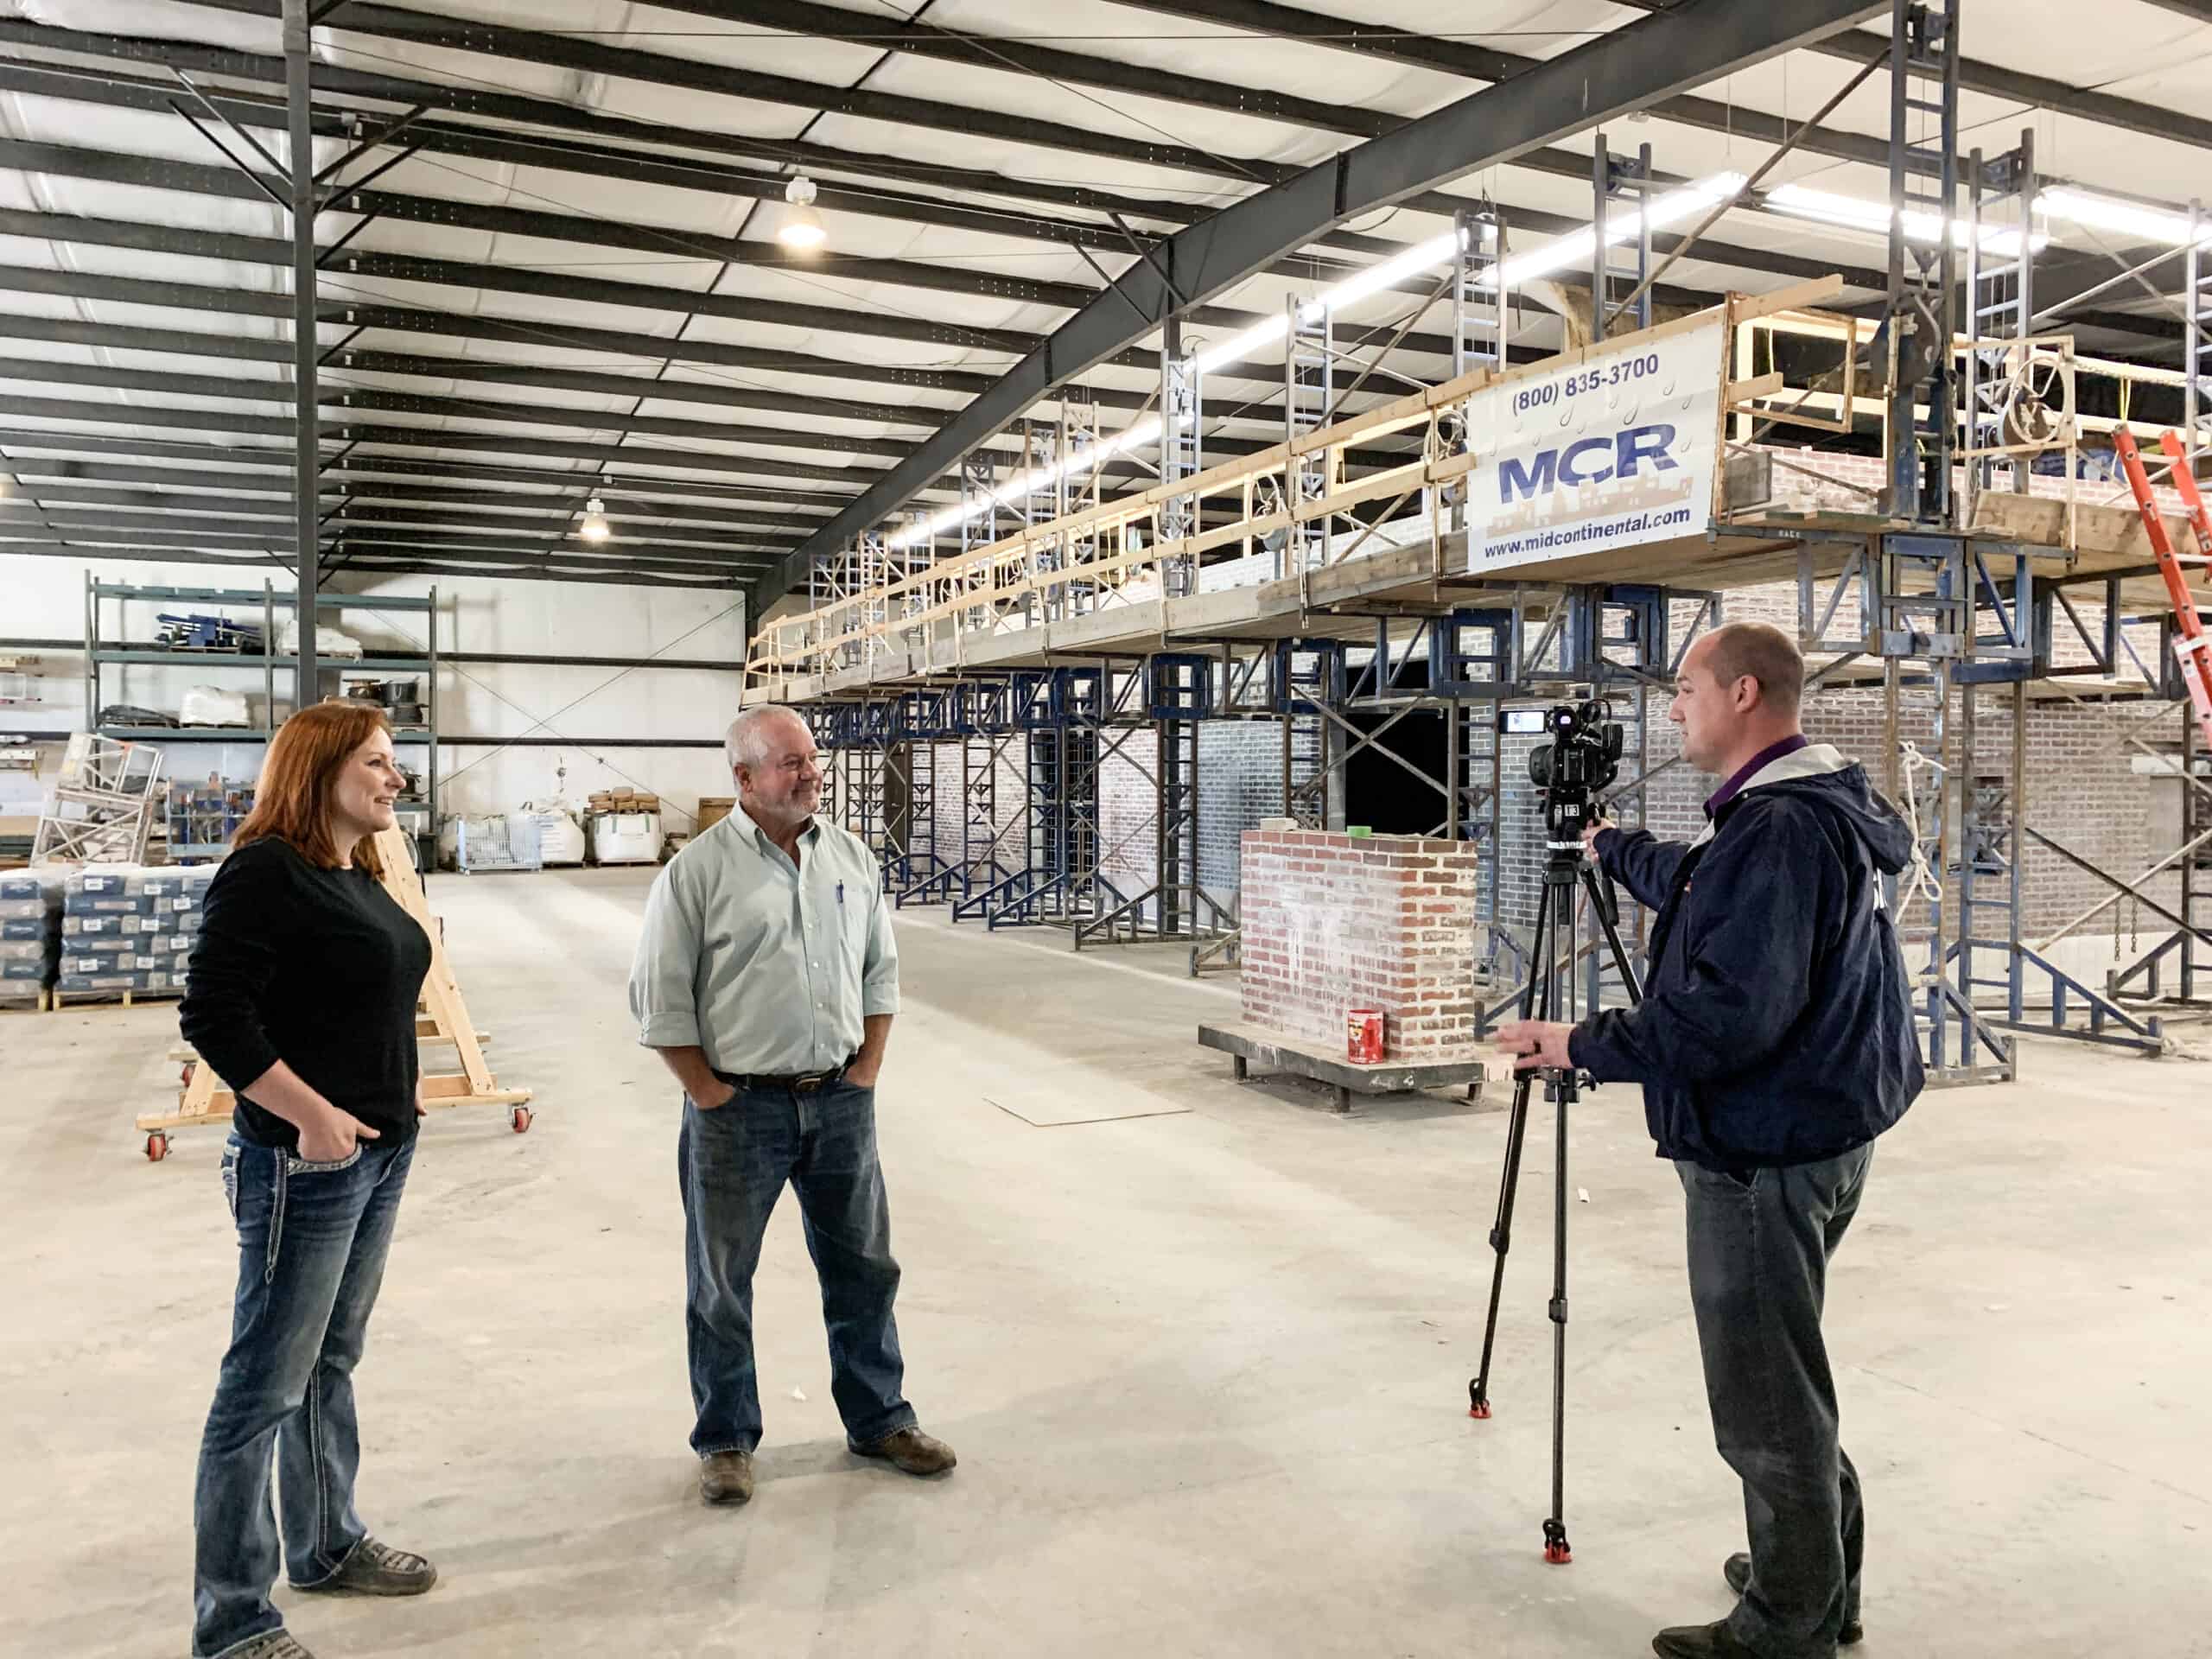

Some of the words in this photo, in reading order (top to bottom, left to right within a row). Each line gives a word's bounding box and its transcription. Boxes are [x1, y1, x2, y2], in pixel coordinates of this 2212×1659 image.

[1512, 383, 1559, 416] (800)
[1566, 354, 1658, 397] 835-3700
[1498, 423, 1679, 505] MCR
[1485, 508, 1690, 557] www.midcontinental.com
